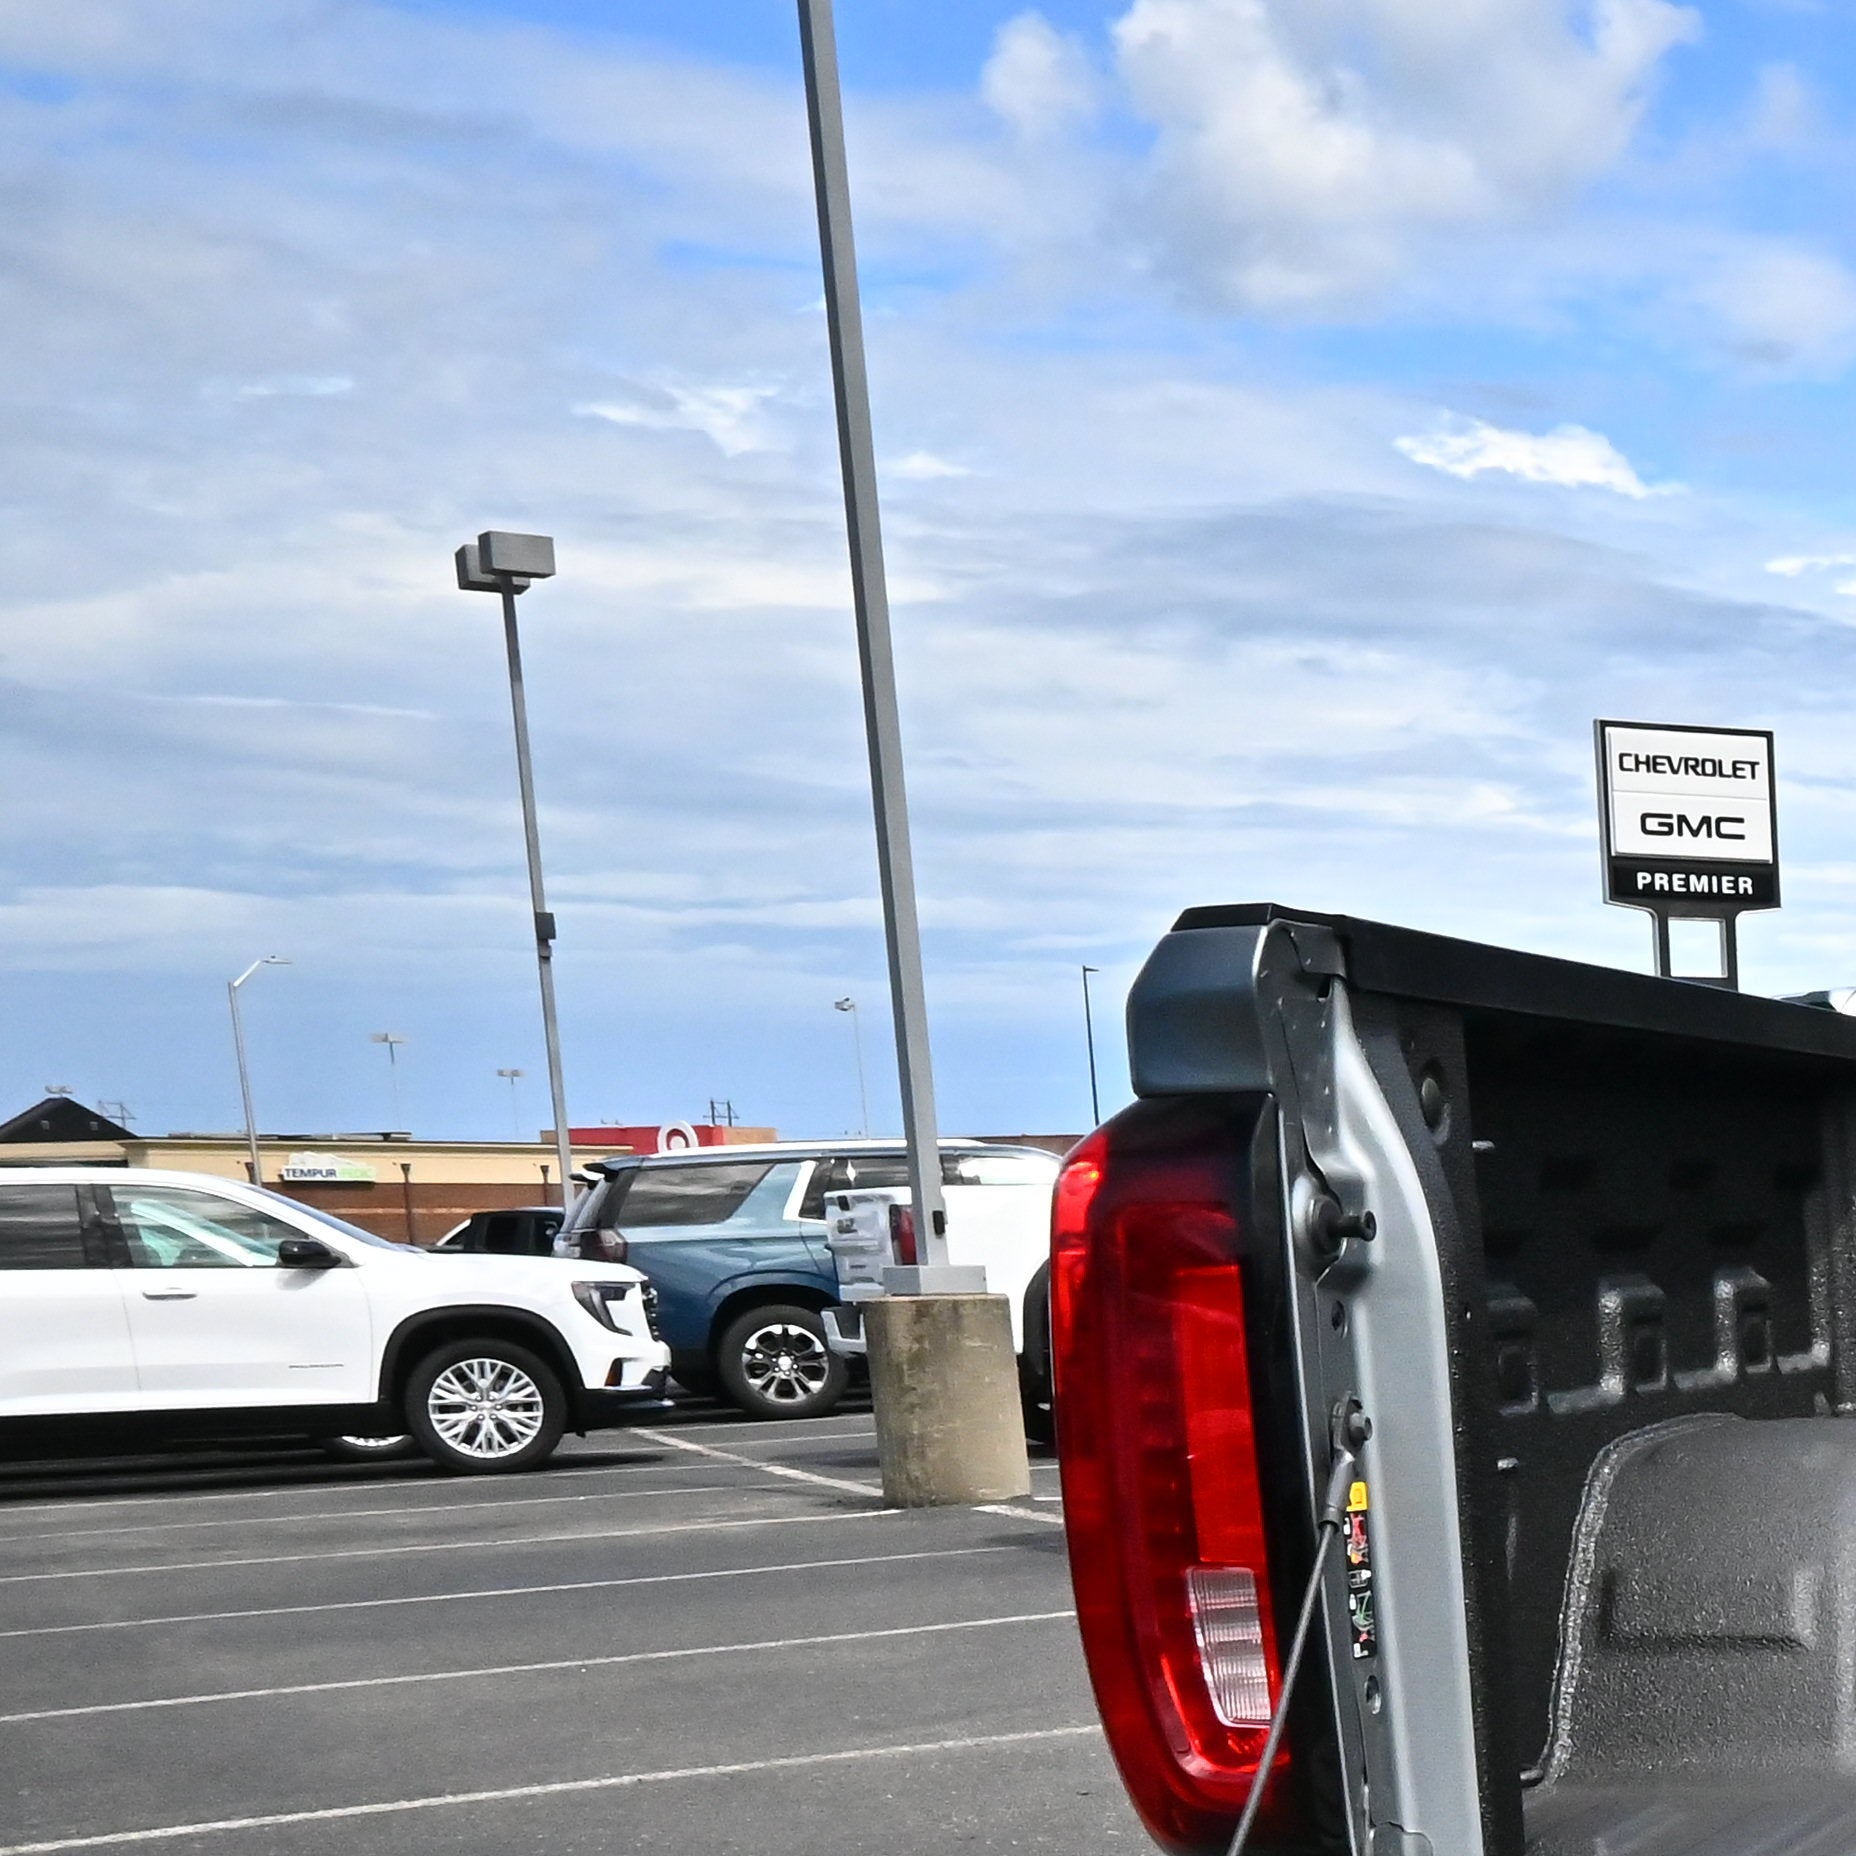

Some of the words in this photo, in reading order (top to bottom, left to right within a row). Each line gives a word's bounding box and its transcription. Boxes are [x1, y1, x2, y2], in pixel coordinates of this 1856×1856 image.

[1618, 752, 1760, 780] CHEVROLET
[1640, 812, 1745, 840] GMC
[1636, 871, 1753, 894] PREMIER
